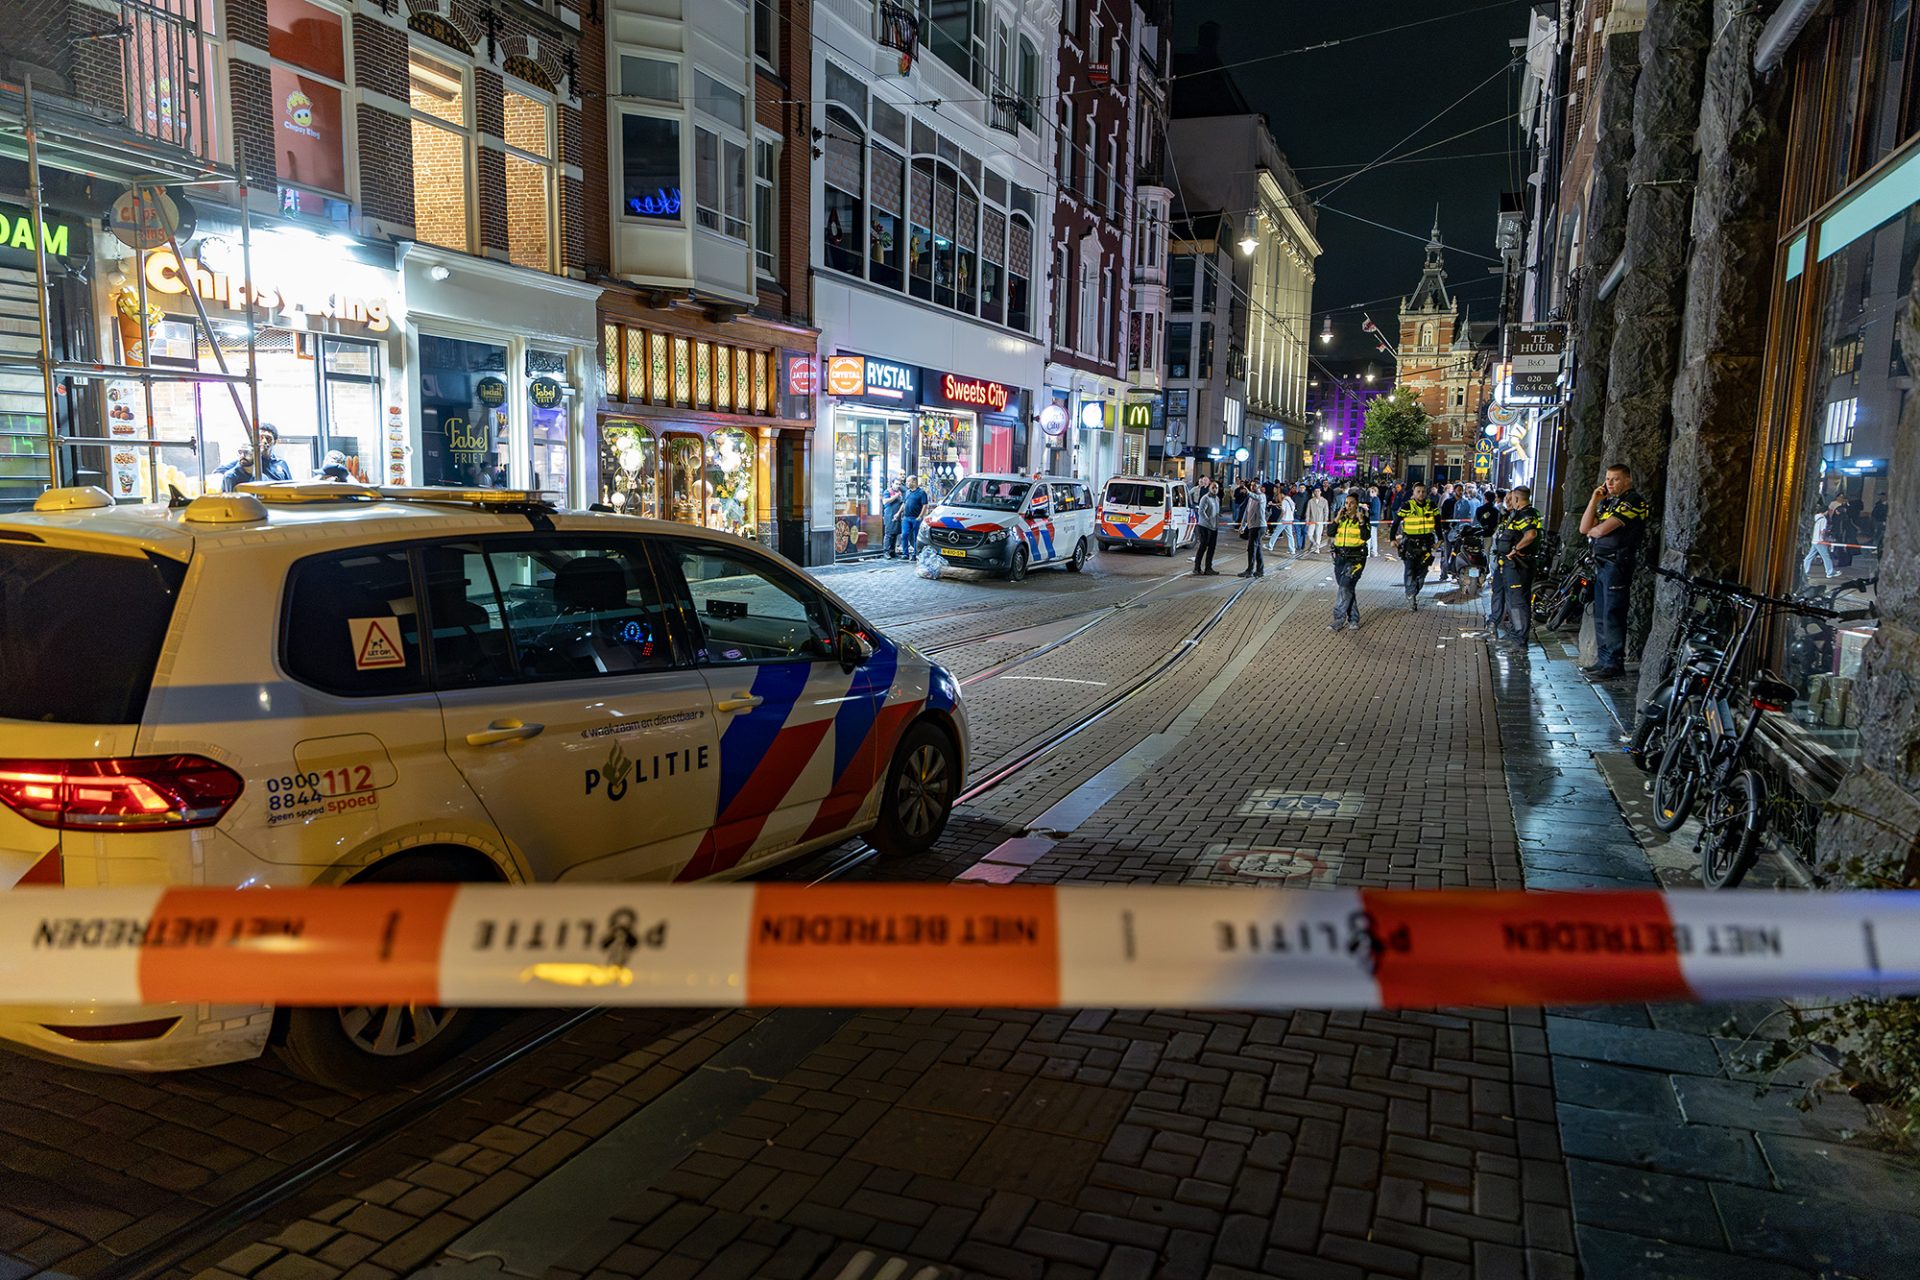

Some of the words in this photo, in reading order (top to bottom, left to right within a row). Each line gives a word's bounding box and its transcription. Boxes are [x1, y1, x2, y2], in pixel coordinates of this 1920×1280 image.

[1520, 344, 1554, 352] HUUR
[1531, 334, 1546, 343] TE
[867, 362, 913, 391] RYSTAL
[1527, 359, 1546, 367] B&O
[533, 383, 556, 398] Fabel
[946, 374, 986, 404] Sweets
[988, 383, 1008, 412] City
[444, 417, 489, 451] Fabel
[454, 453, 485, 464] FRIET
[641, 718, 652, 728] en
[266, 772, 320, 793] 0900
[323, 765, 374, 790] 112
[585, 745, 708, 801] POLITIE
[269, 789, 323, 811] 8844
[327, 791, 377, 814] spoed
[268, 811, 294, 823] geen
[297, 807, 325, 818] spoed
[33, 916, 220, 949] BETREDEN
[475, 906, 668, 954] POLITIE
[759, 914, 950, 946] BETREDEN
[958, 915, 1038, 946] NIET
[1216, 910, 1412, 955] POLITIE
[1502, 920, 1694, 956] BETREDEN
[1706, 922, 1782, 957] NIET
